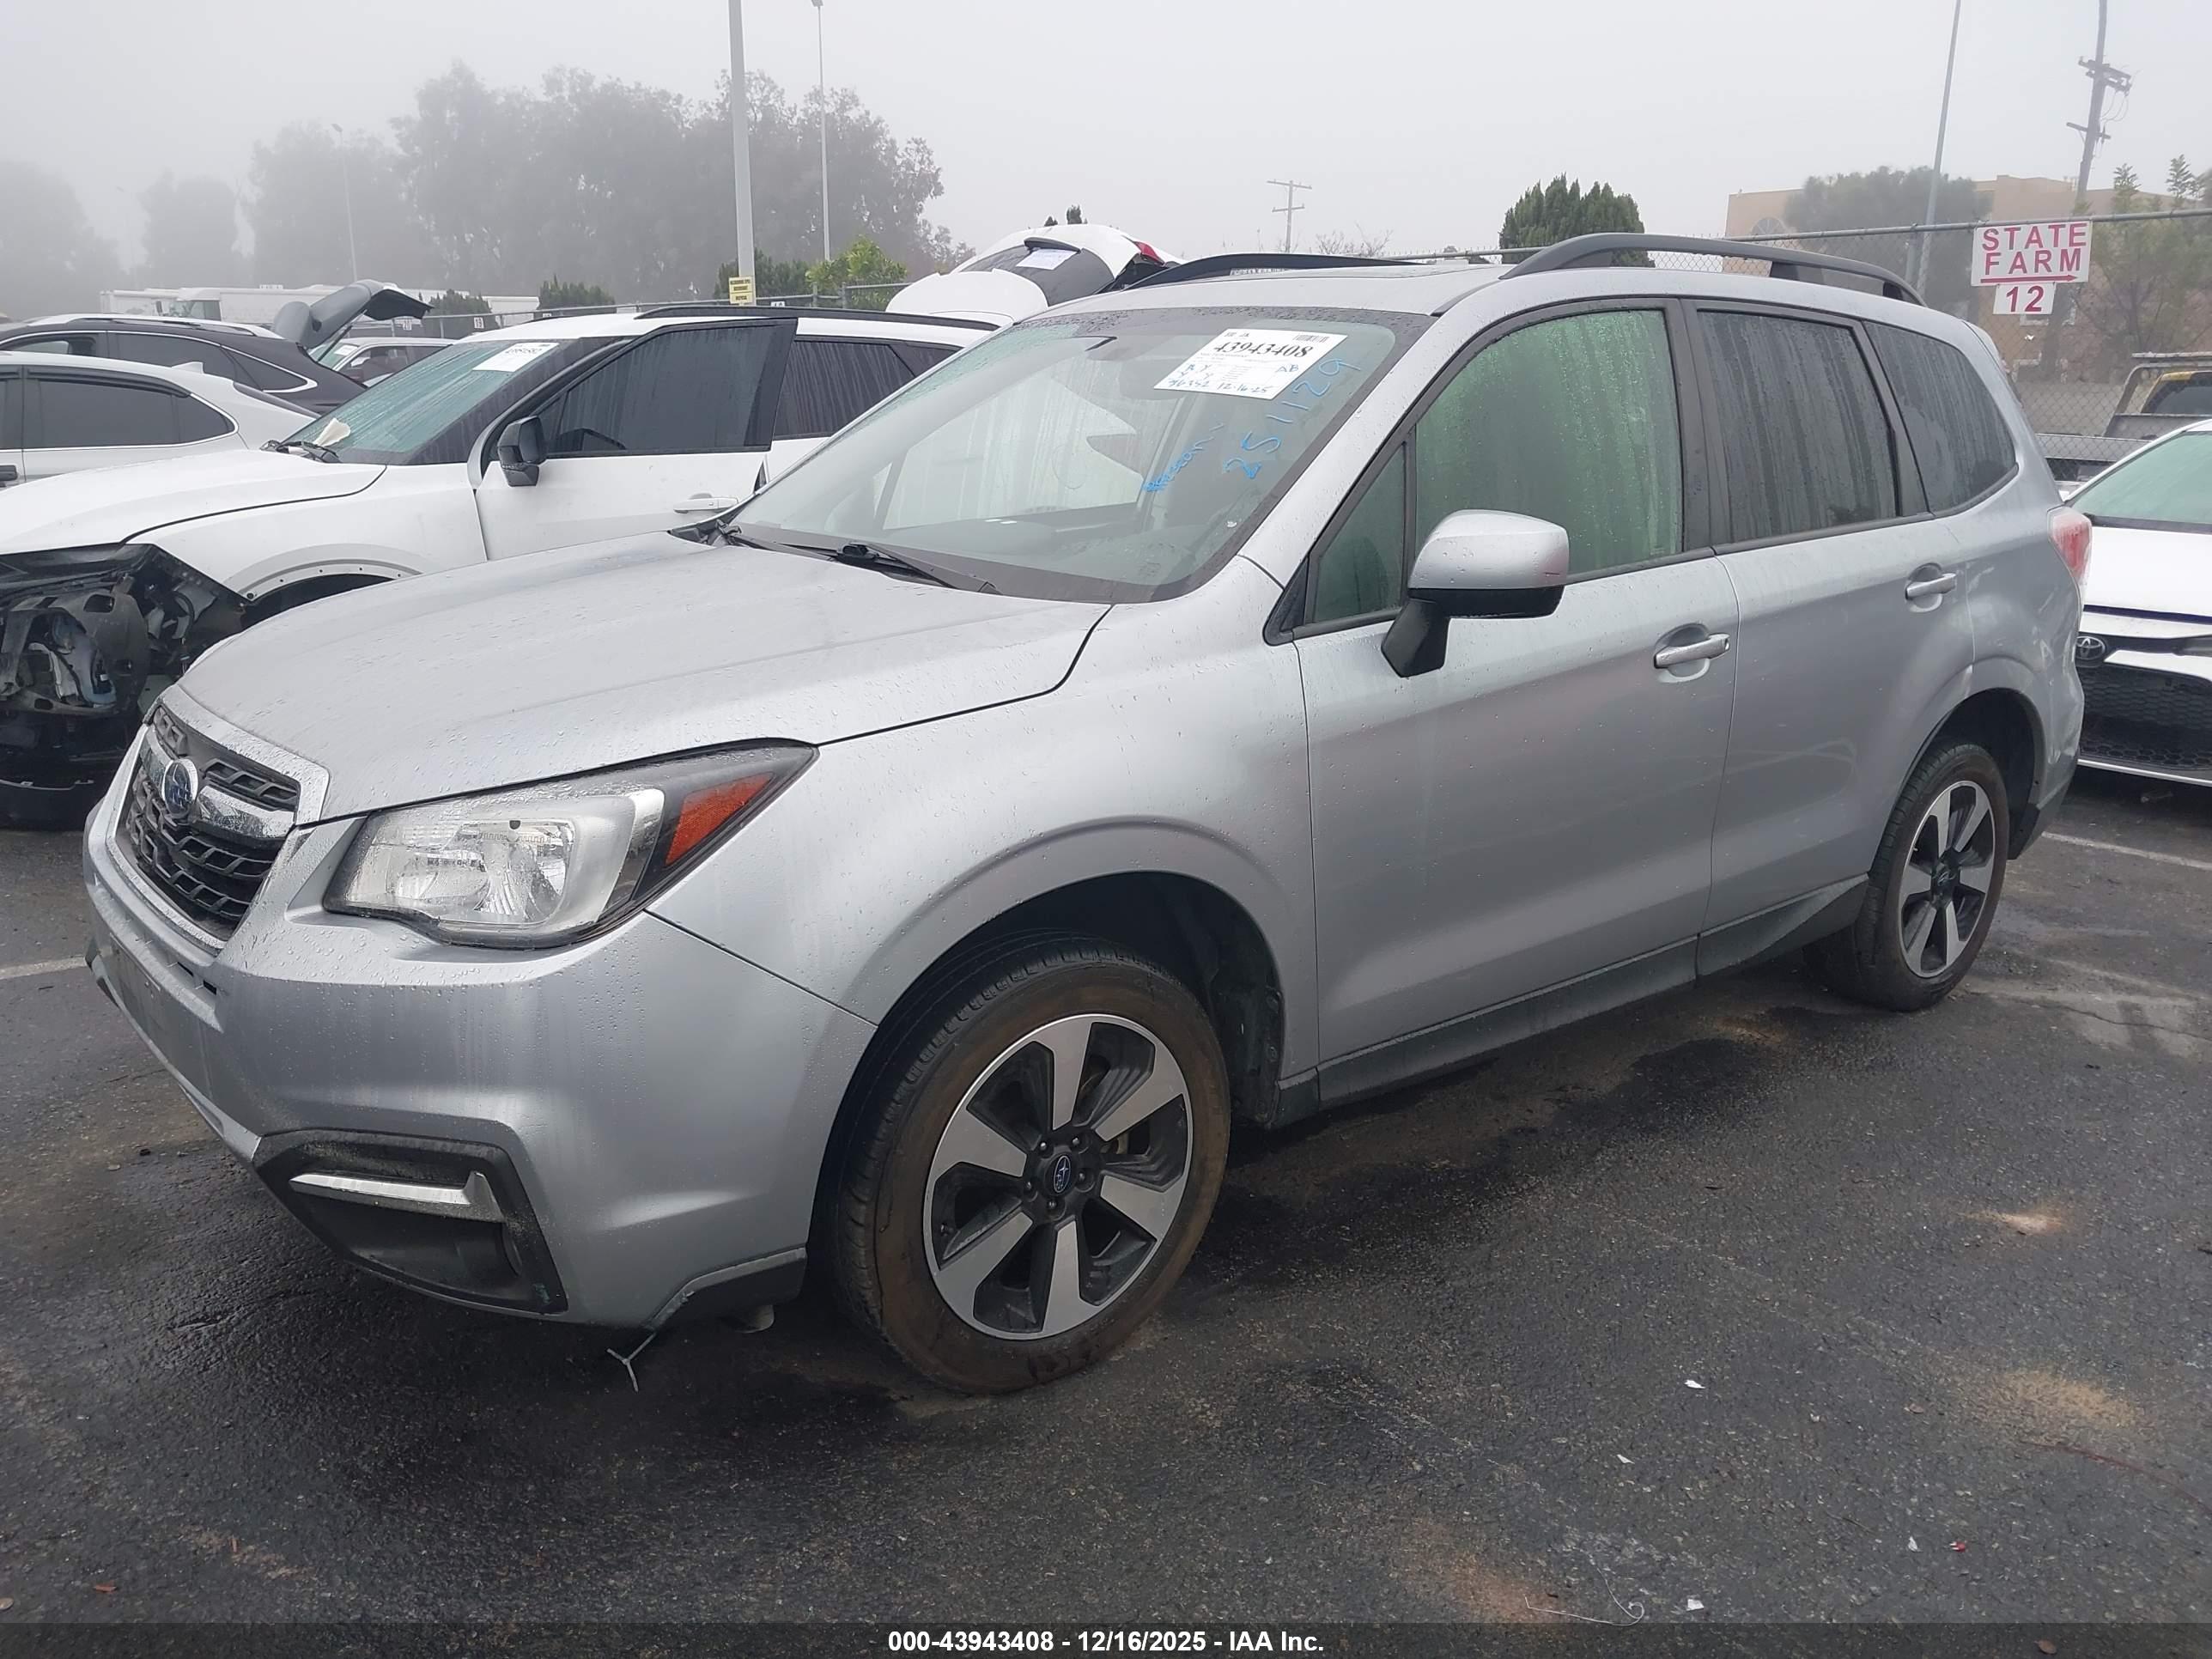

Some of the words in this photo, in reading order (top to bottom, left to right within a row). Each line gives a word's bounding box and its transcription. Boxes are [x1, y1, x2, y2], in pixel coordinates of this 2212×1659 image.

[1982, 222, 2087, 251] STATE
[1984, 248, 2081, 276] FARM
[2006, 285, 2045, 313] 12
[1213, 342, 1314, 358] 43943408
